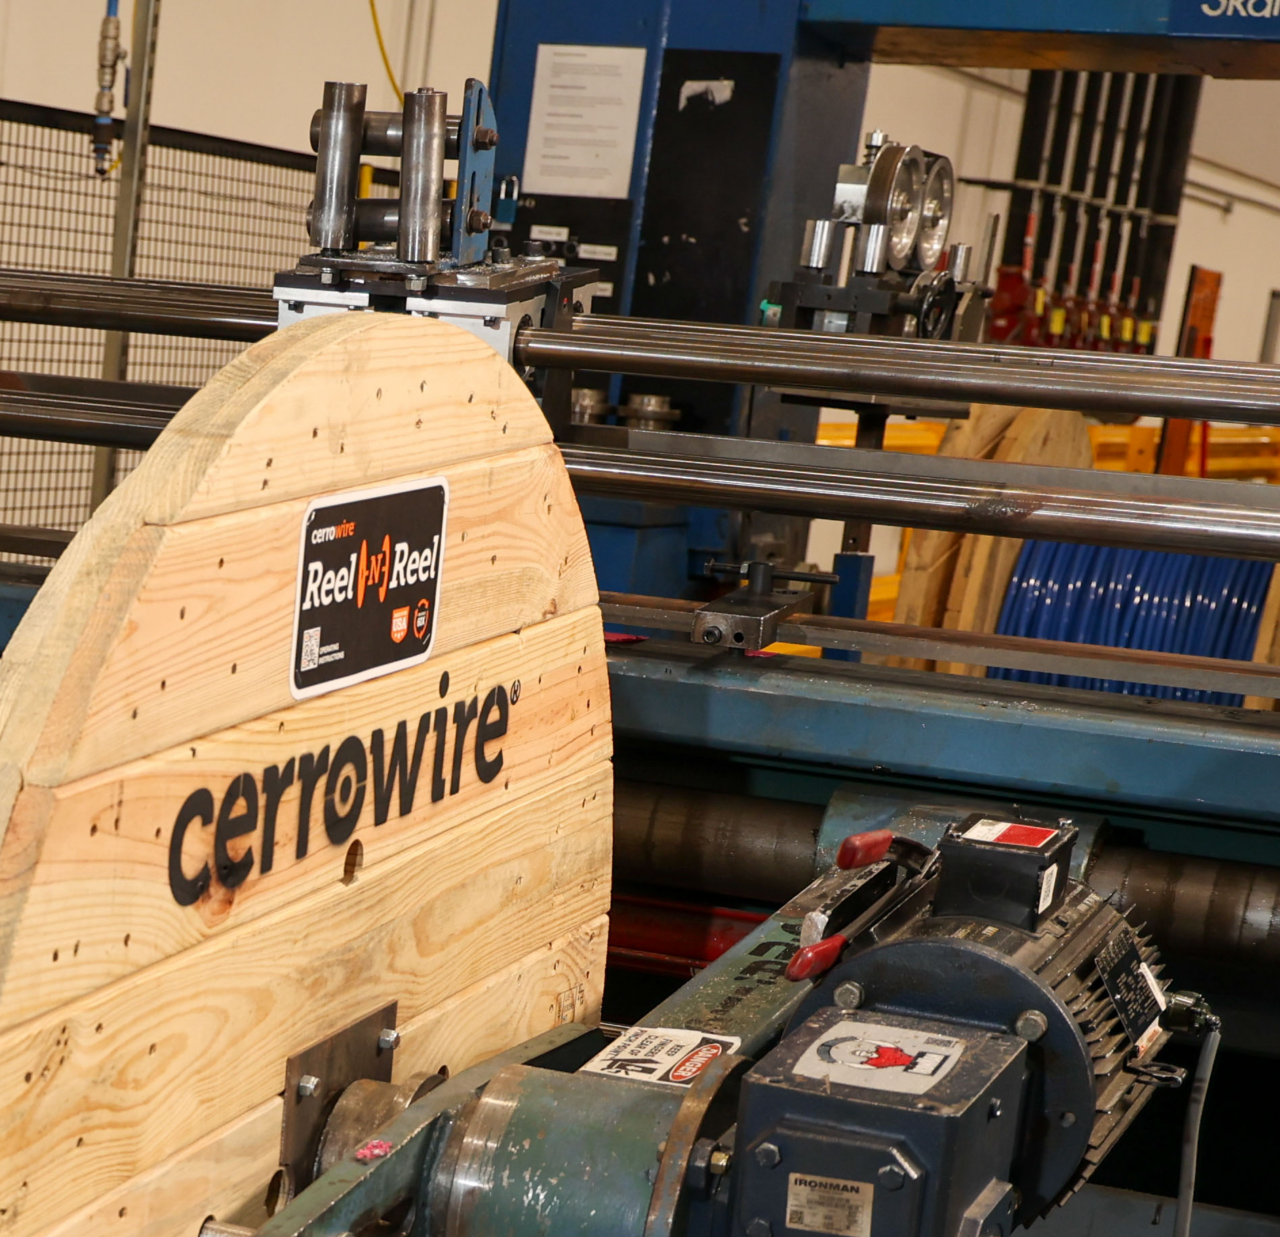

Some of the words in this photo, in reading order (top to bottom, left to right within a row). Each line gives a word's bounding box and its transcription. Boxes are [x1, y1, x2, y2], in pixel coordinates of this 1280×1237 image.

[311, 519, 357, 545] cerrowire
[302, 552, 358, 611] Reel
[389, 534, 440, 589] Reel
[628, 1048, 641, 1056] OF
[636, 1034, 658, 1050] CLEAR
[644, 1038, 673, 1058] FINGERS
[673, 1046, 718, 1077] DANGER
[794, 1178, 860, 1194] IRONMAN
